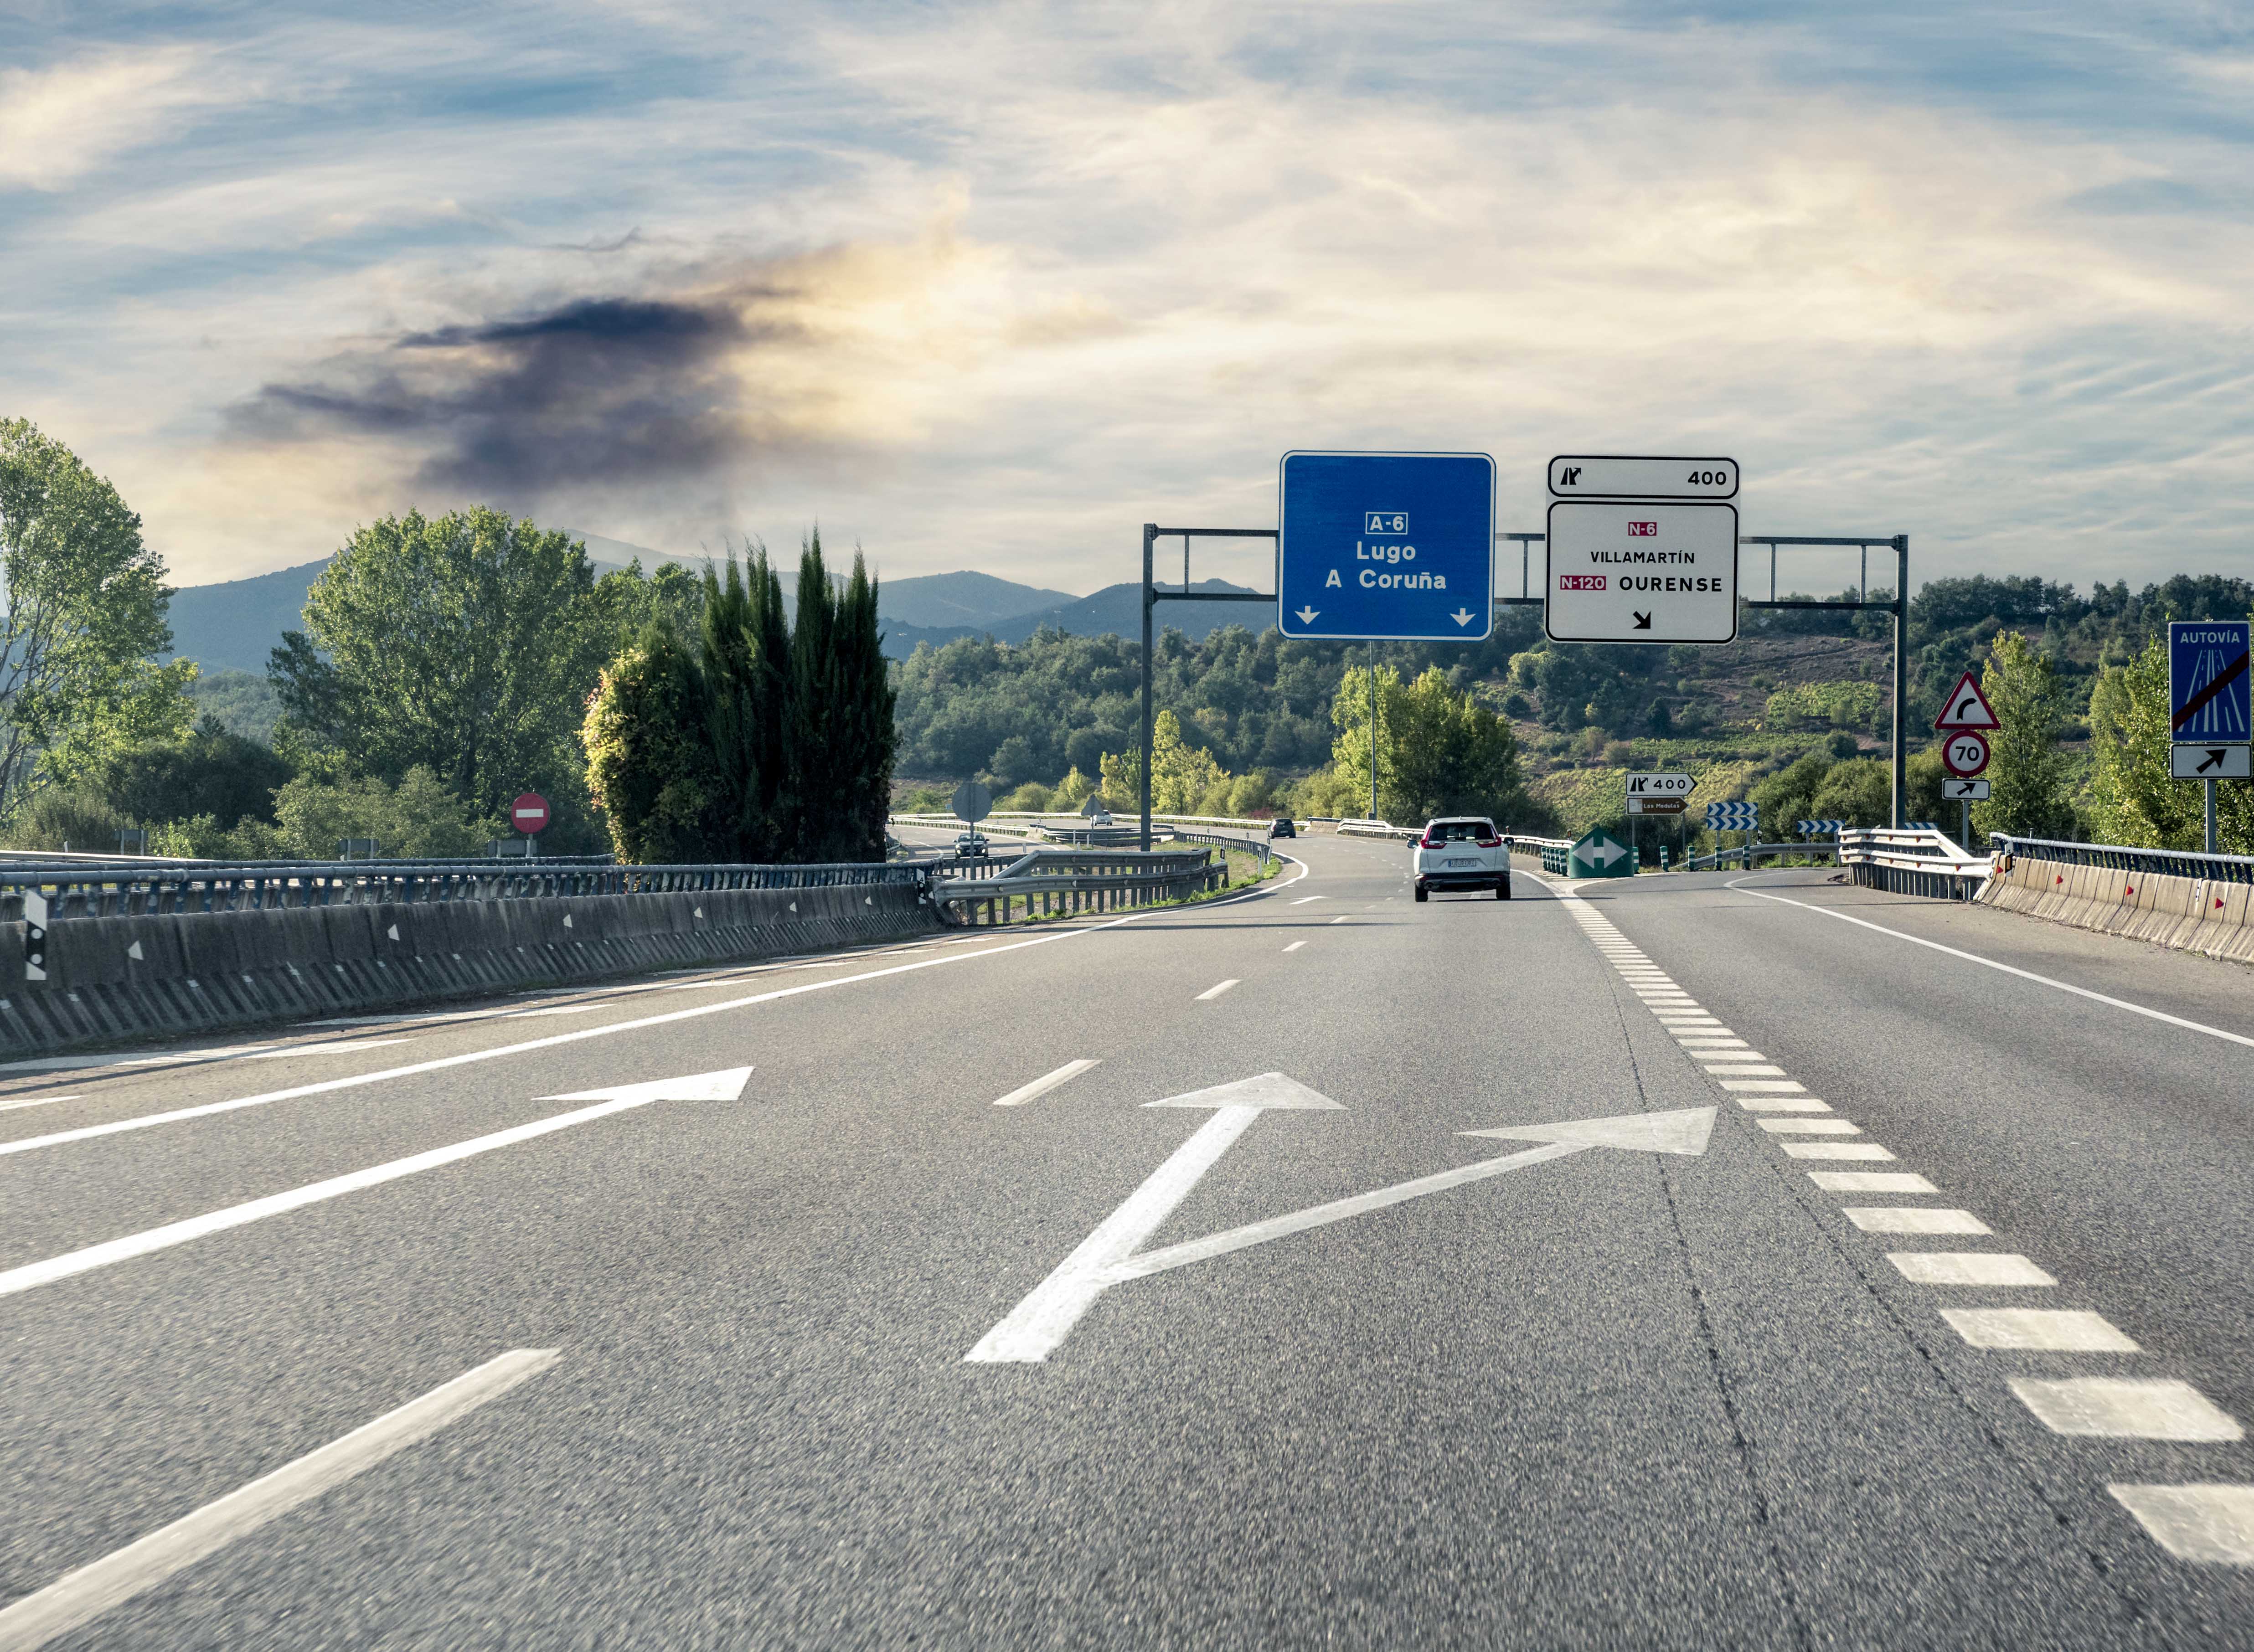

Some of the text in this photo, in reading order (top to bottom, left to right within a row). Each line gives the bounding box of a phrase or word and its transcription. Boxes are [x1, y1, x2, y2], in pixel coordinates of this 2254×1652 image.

[1687, 471, 1727, 485] 400
[1370, 515, 1404, 531] A-6
[1630, 523, 1656, 535] N-6
[1357, 541, 1416, 564] Lugo
[1590, 550, 1695, 564] VILLAMARTÍN
[1325, 569, 1446, 589] A Coruña
[1562, 576, 1722, 592] N-120 OURENSE
[2180, 629, 2241, 643] AUTOVÍA
[1955, 746, 1980, 762] 70
[1653, 779, 1686, 789] 400
